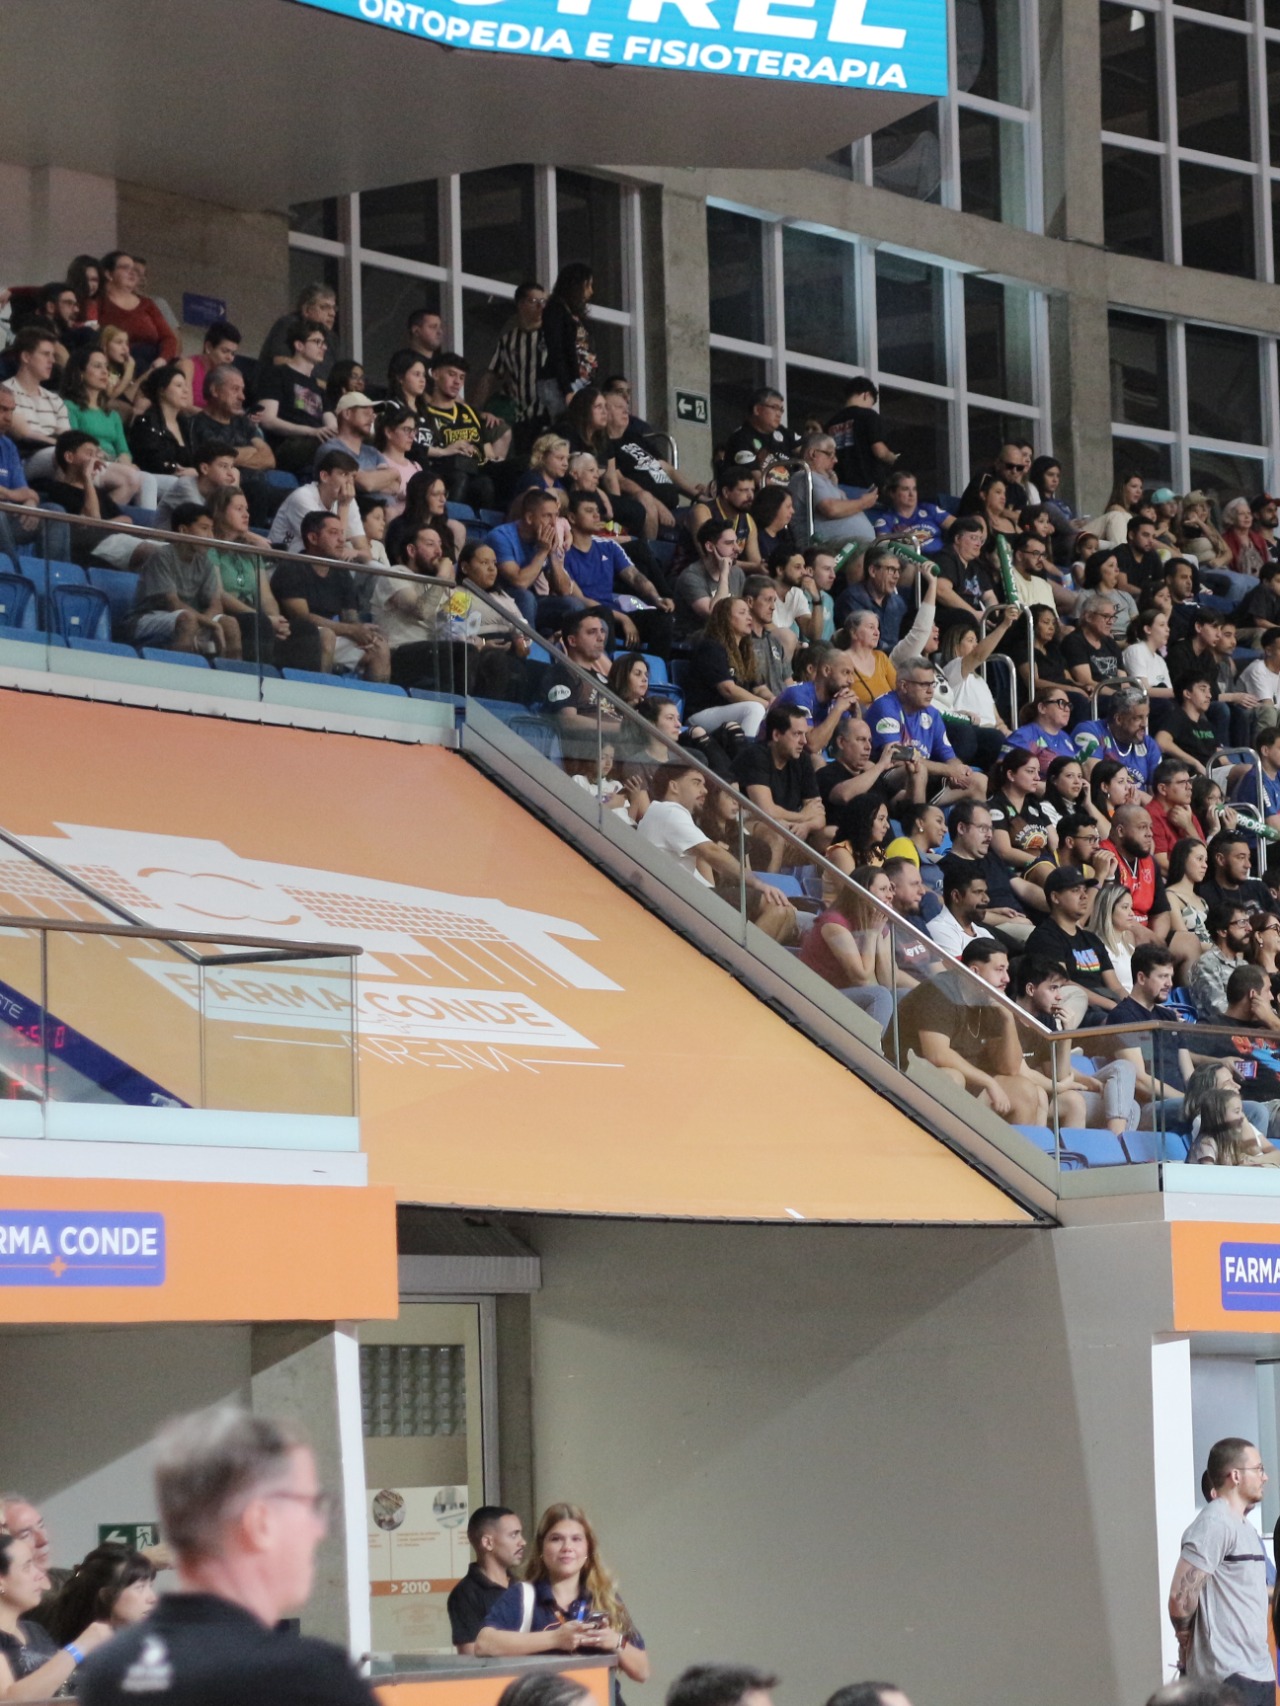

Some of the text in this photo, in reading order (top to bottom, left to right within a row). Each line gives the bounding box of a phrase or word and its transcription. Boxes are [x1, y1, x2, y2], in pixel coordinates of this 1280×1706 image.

[359, 0, 573, 54] ORTOPEDIA
[585, 32, 614, 58] E
[623, 36, 907, 89] FISIOTERAPIA
[163, 972, 554, 1027] FARMA CONDE
[340, 1034, 540, 1073] ARENA
[60, 1226, 157, 1255] CONDE
[401, 1581, 431, 1593] 2010
